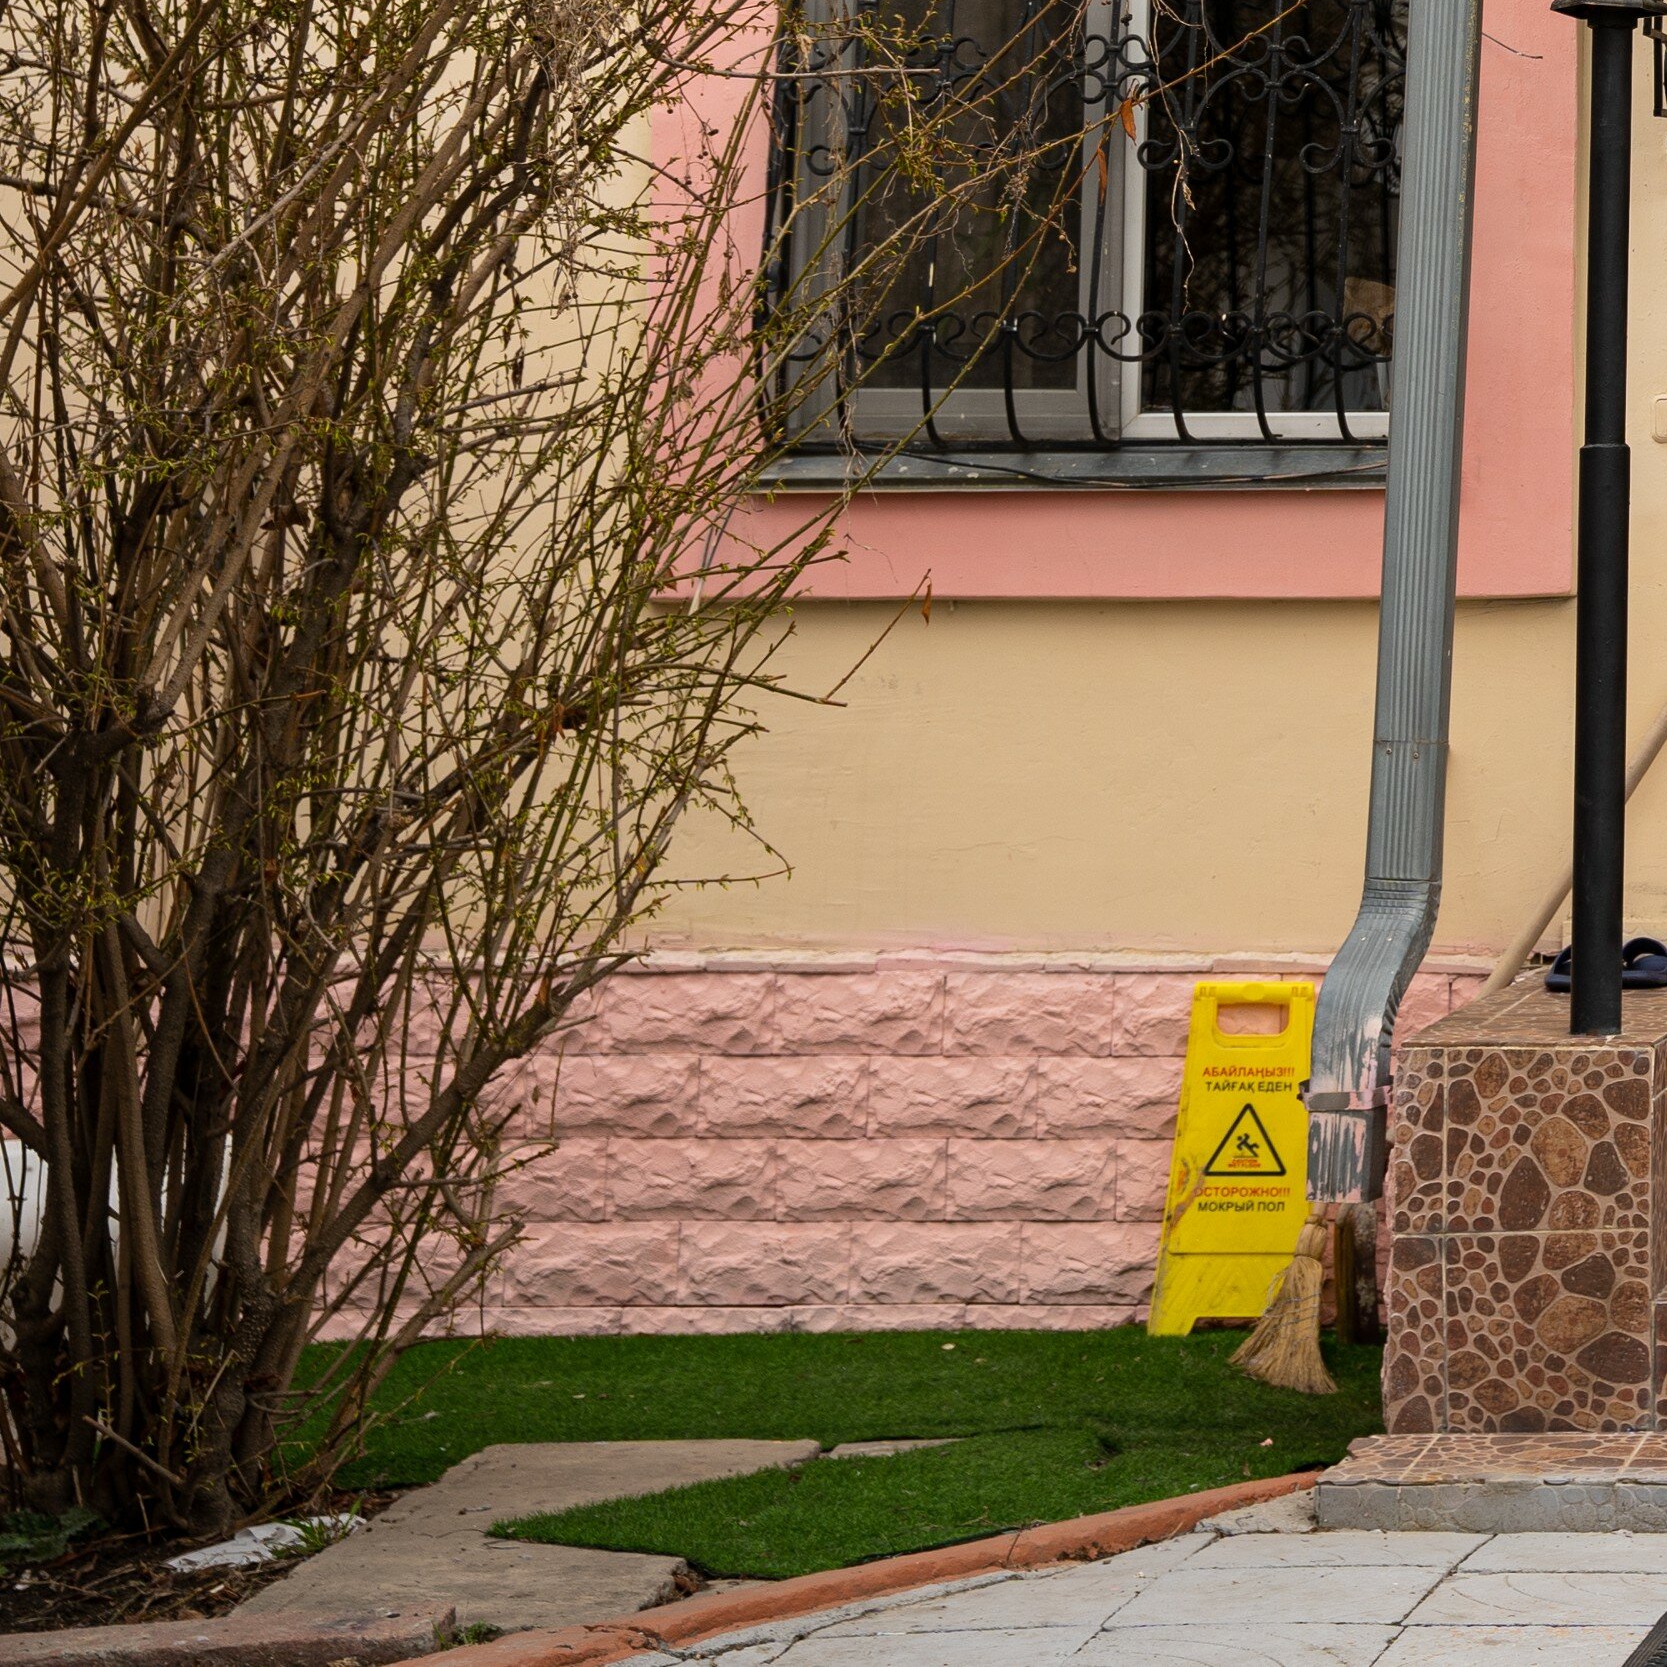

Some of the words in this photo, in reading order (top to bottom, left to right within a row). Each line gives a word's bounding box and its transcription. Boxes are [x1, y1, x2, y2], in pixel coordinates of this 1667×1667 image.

[1206, 1079, 1255, 1093] ТАЙҒАҚ
[1257, 1081, 1292, 1092] ЕДЕН
[1194, 1186, 1290, 1197] ОСТОРОЖНО!!!
[1198, 1200, 1254, 1212] МОКРЫЙ
[1257, 1201, 1285, 1212] ПОЛ
